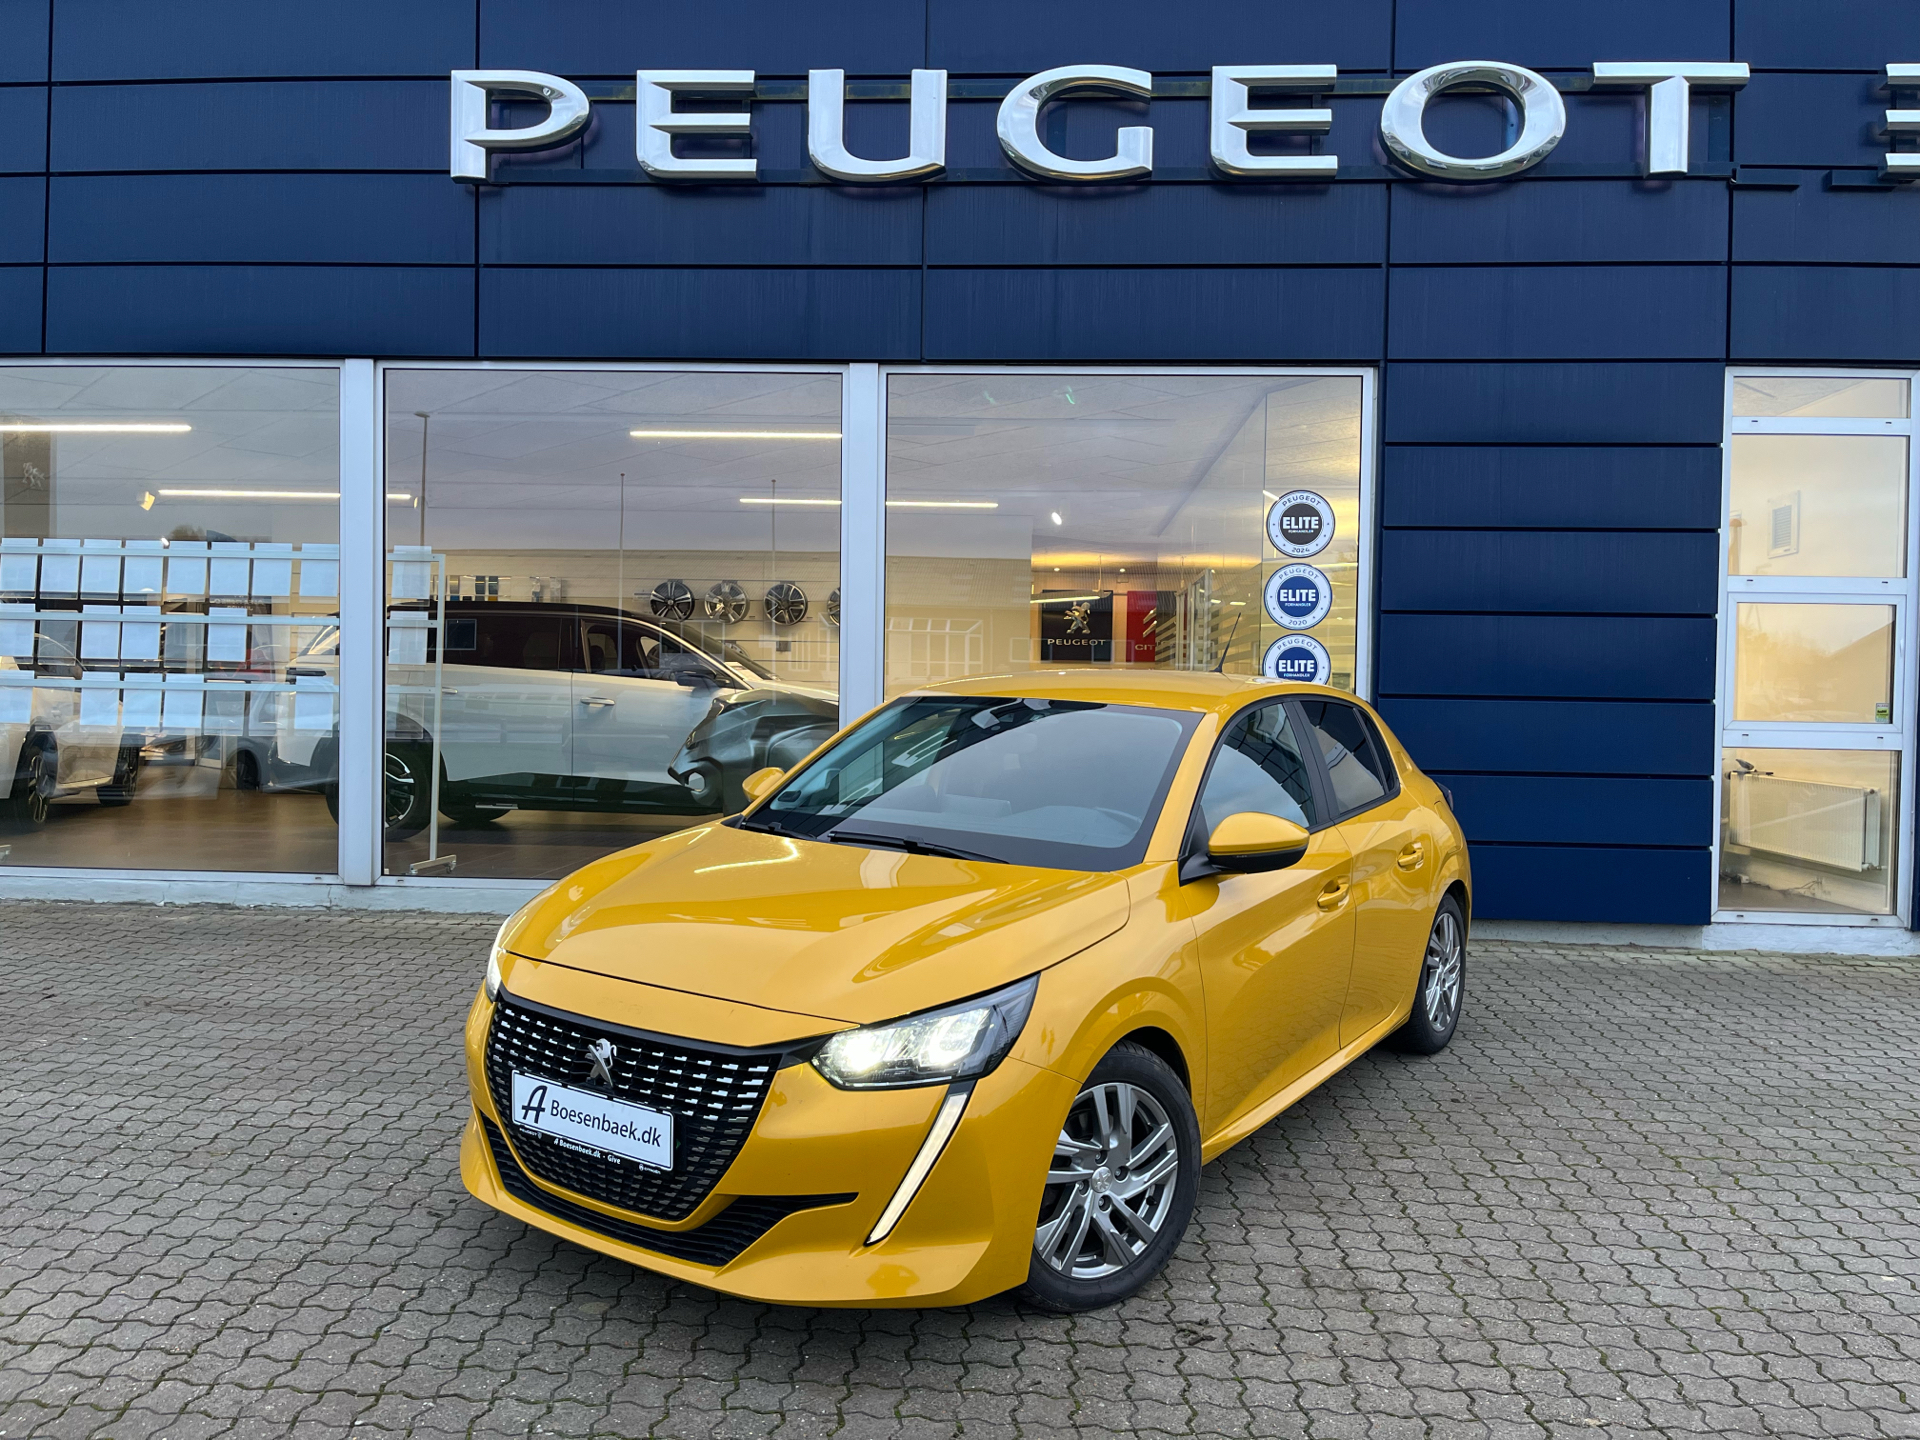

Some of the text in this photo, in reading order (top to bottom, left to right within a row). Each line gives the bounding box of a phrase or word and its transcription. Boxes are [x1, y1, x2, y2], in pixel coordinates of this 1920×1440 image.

[450, 60, 1750, 186] PEUGEOT
[1282, 495, 1321, 507] PEUGEOT
[1282, 516, 1319, 529] ELITE
[1278, 568, 1319, 580] PEUGEOT
[1279, 589, 1316, 602] ELITE
[1047, 638, 1106, 646] PEUGEOT
[1276, 638, 1318, 650] PEUGEOT
[1278, 659, 1315, 672] ELITE
[550, 1099, 662, 1148] Boesenbaek.dk
[559, 1139, 601, 1158] Boesenbaek.dk
[607, 1154, 621, 1165] Give
